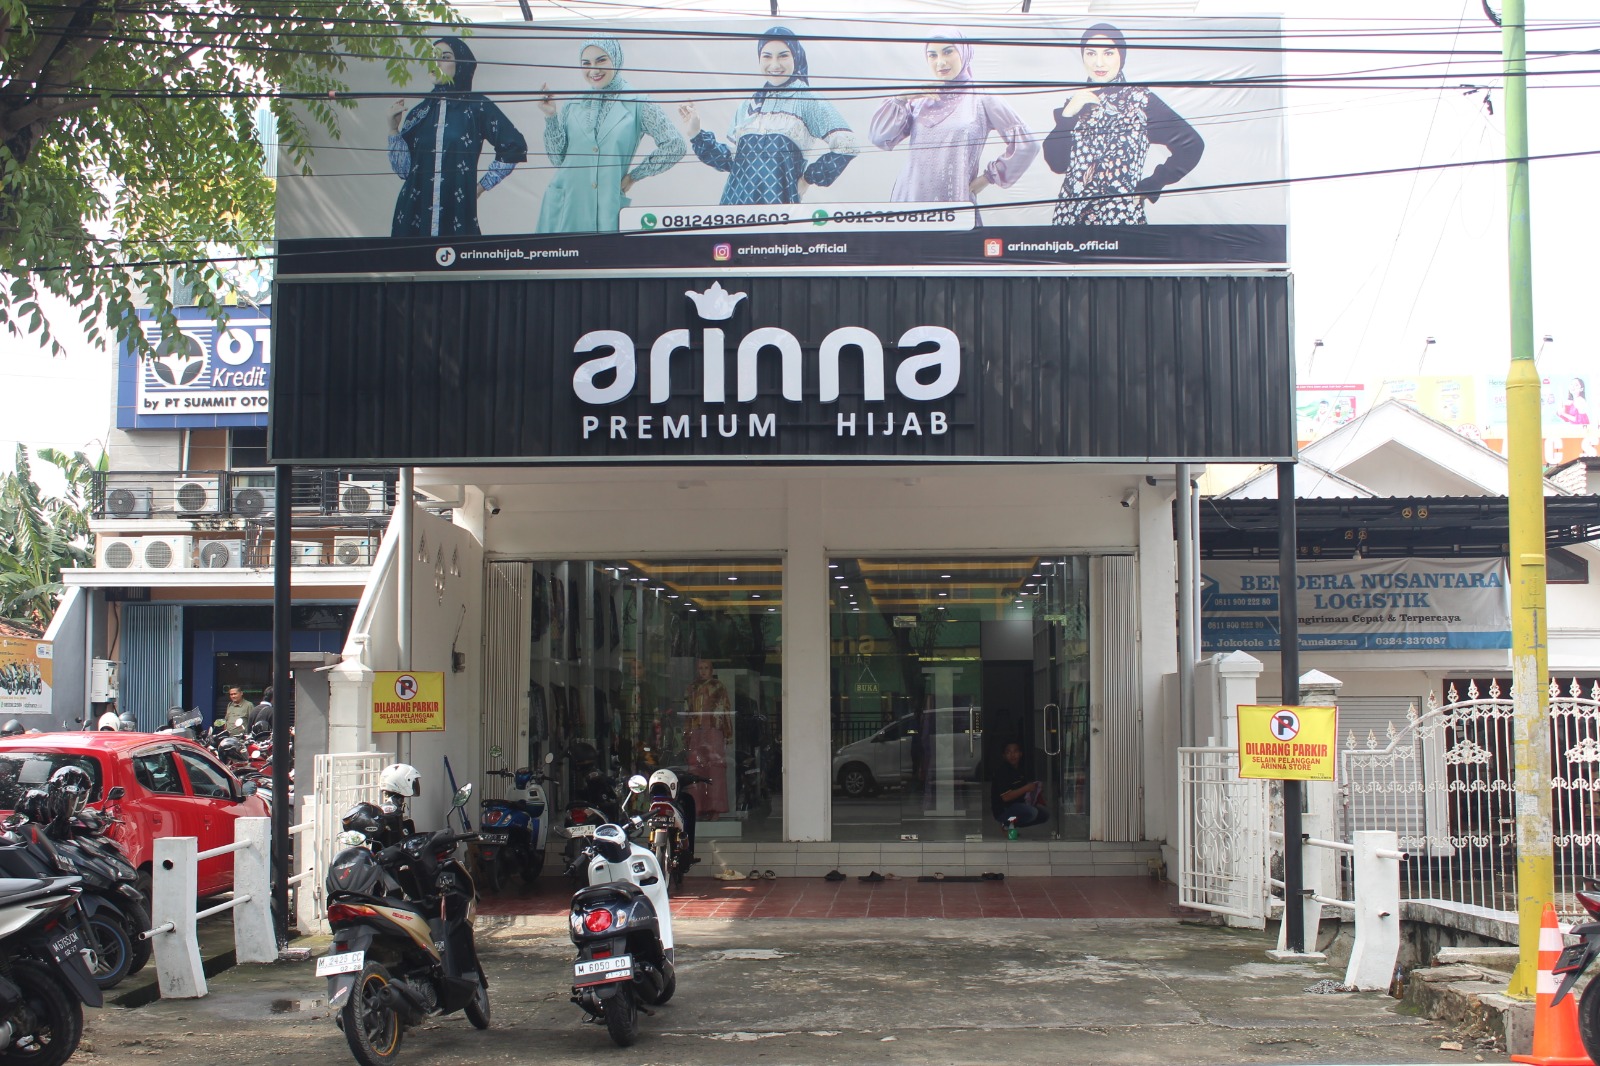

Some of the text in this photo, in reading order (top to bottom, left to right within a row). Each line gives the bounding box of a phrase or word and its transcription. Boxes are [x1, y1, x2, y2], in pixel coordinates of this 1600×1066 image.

[662, 213, 790, 227] 081249364603
[737, 243, 847, 257] arinnahijab_official
[1007, 240, 1119, 254] arinnahijab_official
[460, 248, 579, 261] arinnahijab_premium
[572, 325, 961, 405] arinna
[212, 366, 267, 388] Kredit
[144, 396, 269, 411] by PT SUMMIT OTO
[582, 411, 949, 440] PREMIUM HIJAB
[1360, 572, 1503, 589] NUSANTARA
[1313, 592, 1430, 609] LOGISTIK
[1297, 613, 1461, 625] ngiriman Cepat & Terpercaya
[1216, 638, 1264, 647] Jokotole
[1375, 636, 1447, 646] 0324-337087
[856, 683, 879, 692] BUKA
[374, 702, 439, 712] DILARANG PARKIR
[1245, 742, 1328, 757] DILARANG PARKIR
[1277, 757, 1321, 765] PELANGGAN
[1288, 763, 1312, 771] STORE
[352, 951, 362, 962] CC
[578, 964, 585, 974] M
[589, 961, 610, 972] 6050
